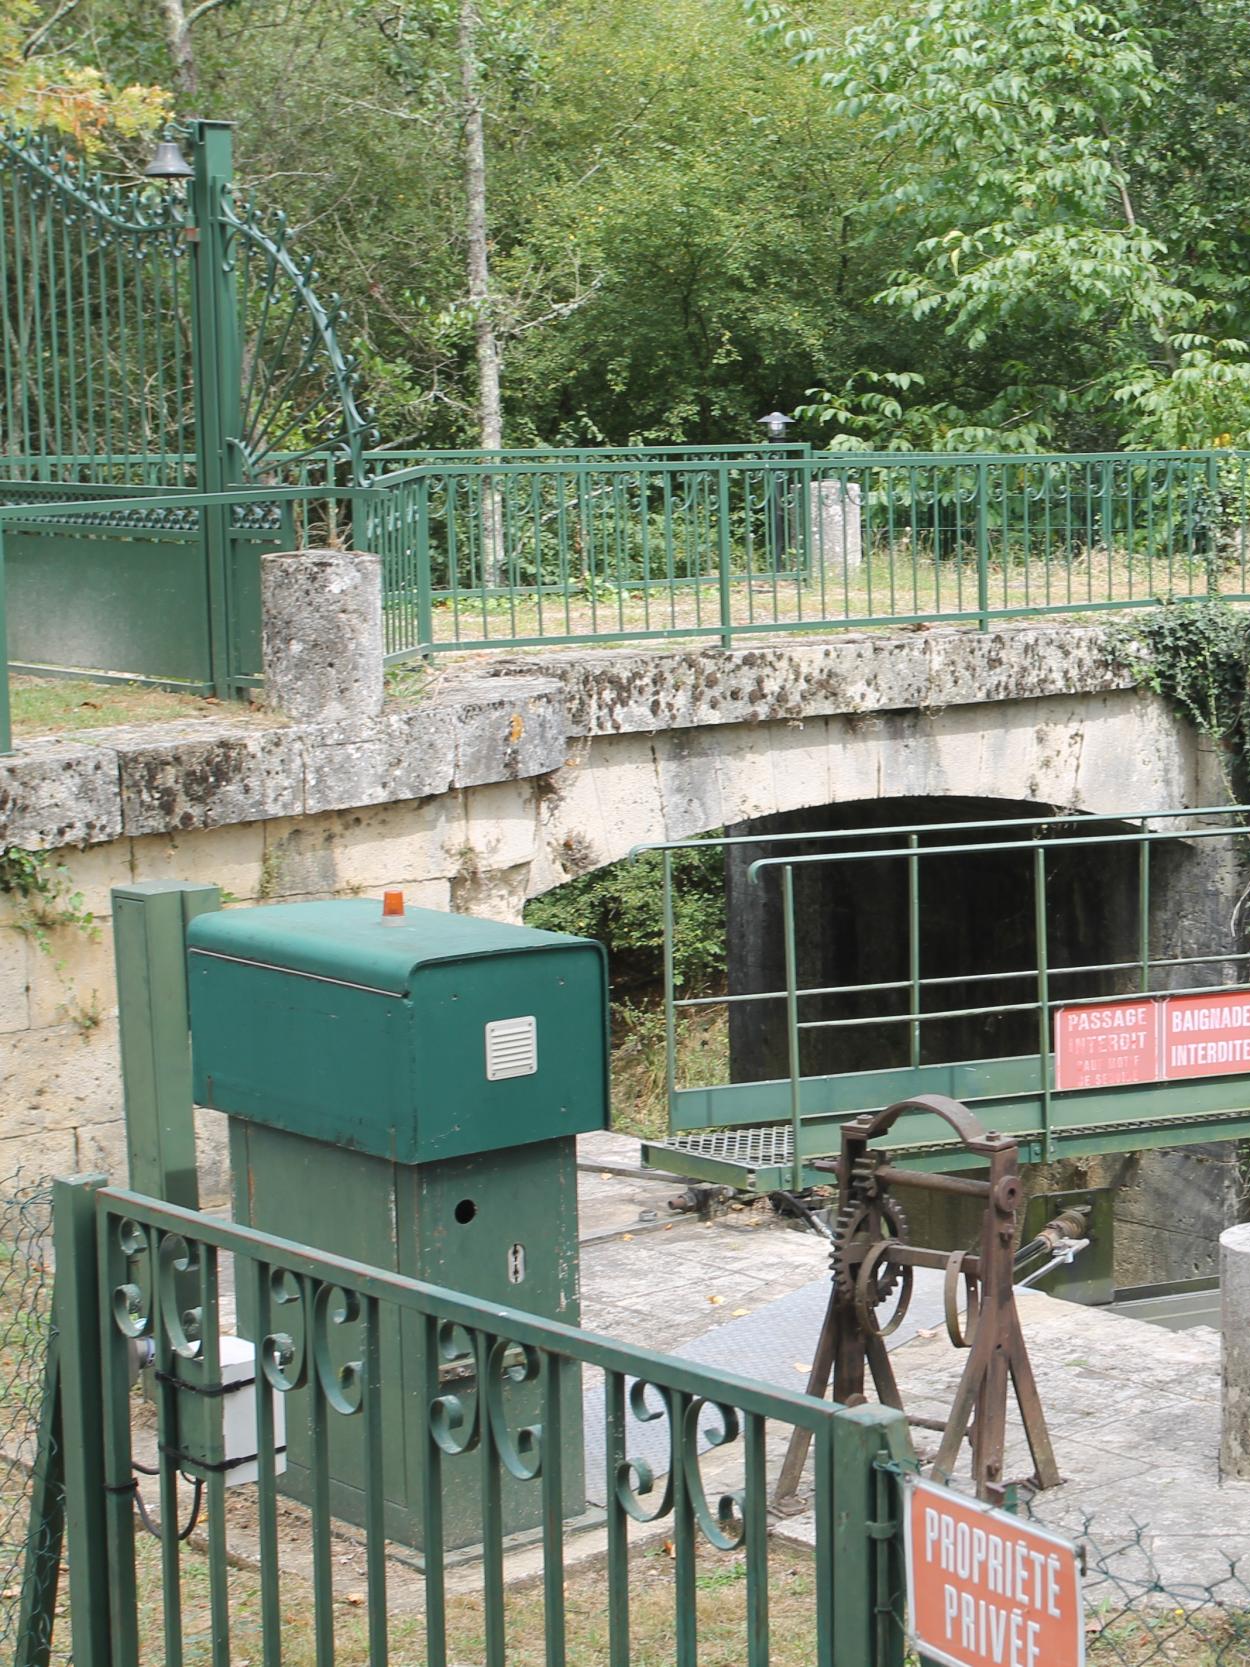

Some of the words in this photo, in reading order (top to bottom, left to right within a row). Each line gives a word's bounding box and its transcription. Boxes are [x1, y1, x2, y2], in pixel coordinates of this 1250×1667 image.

[1067, 1008, 1147, 1032] PASSAGE
[925, 1507, 1061, 1618] PROPRIÉTÉ
[944, 1583, 1041, 1667] PRIVÉE
